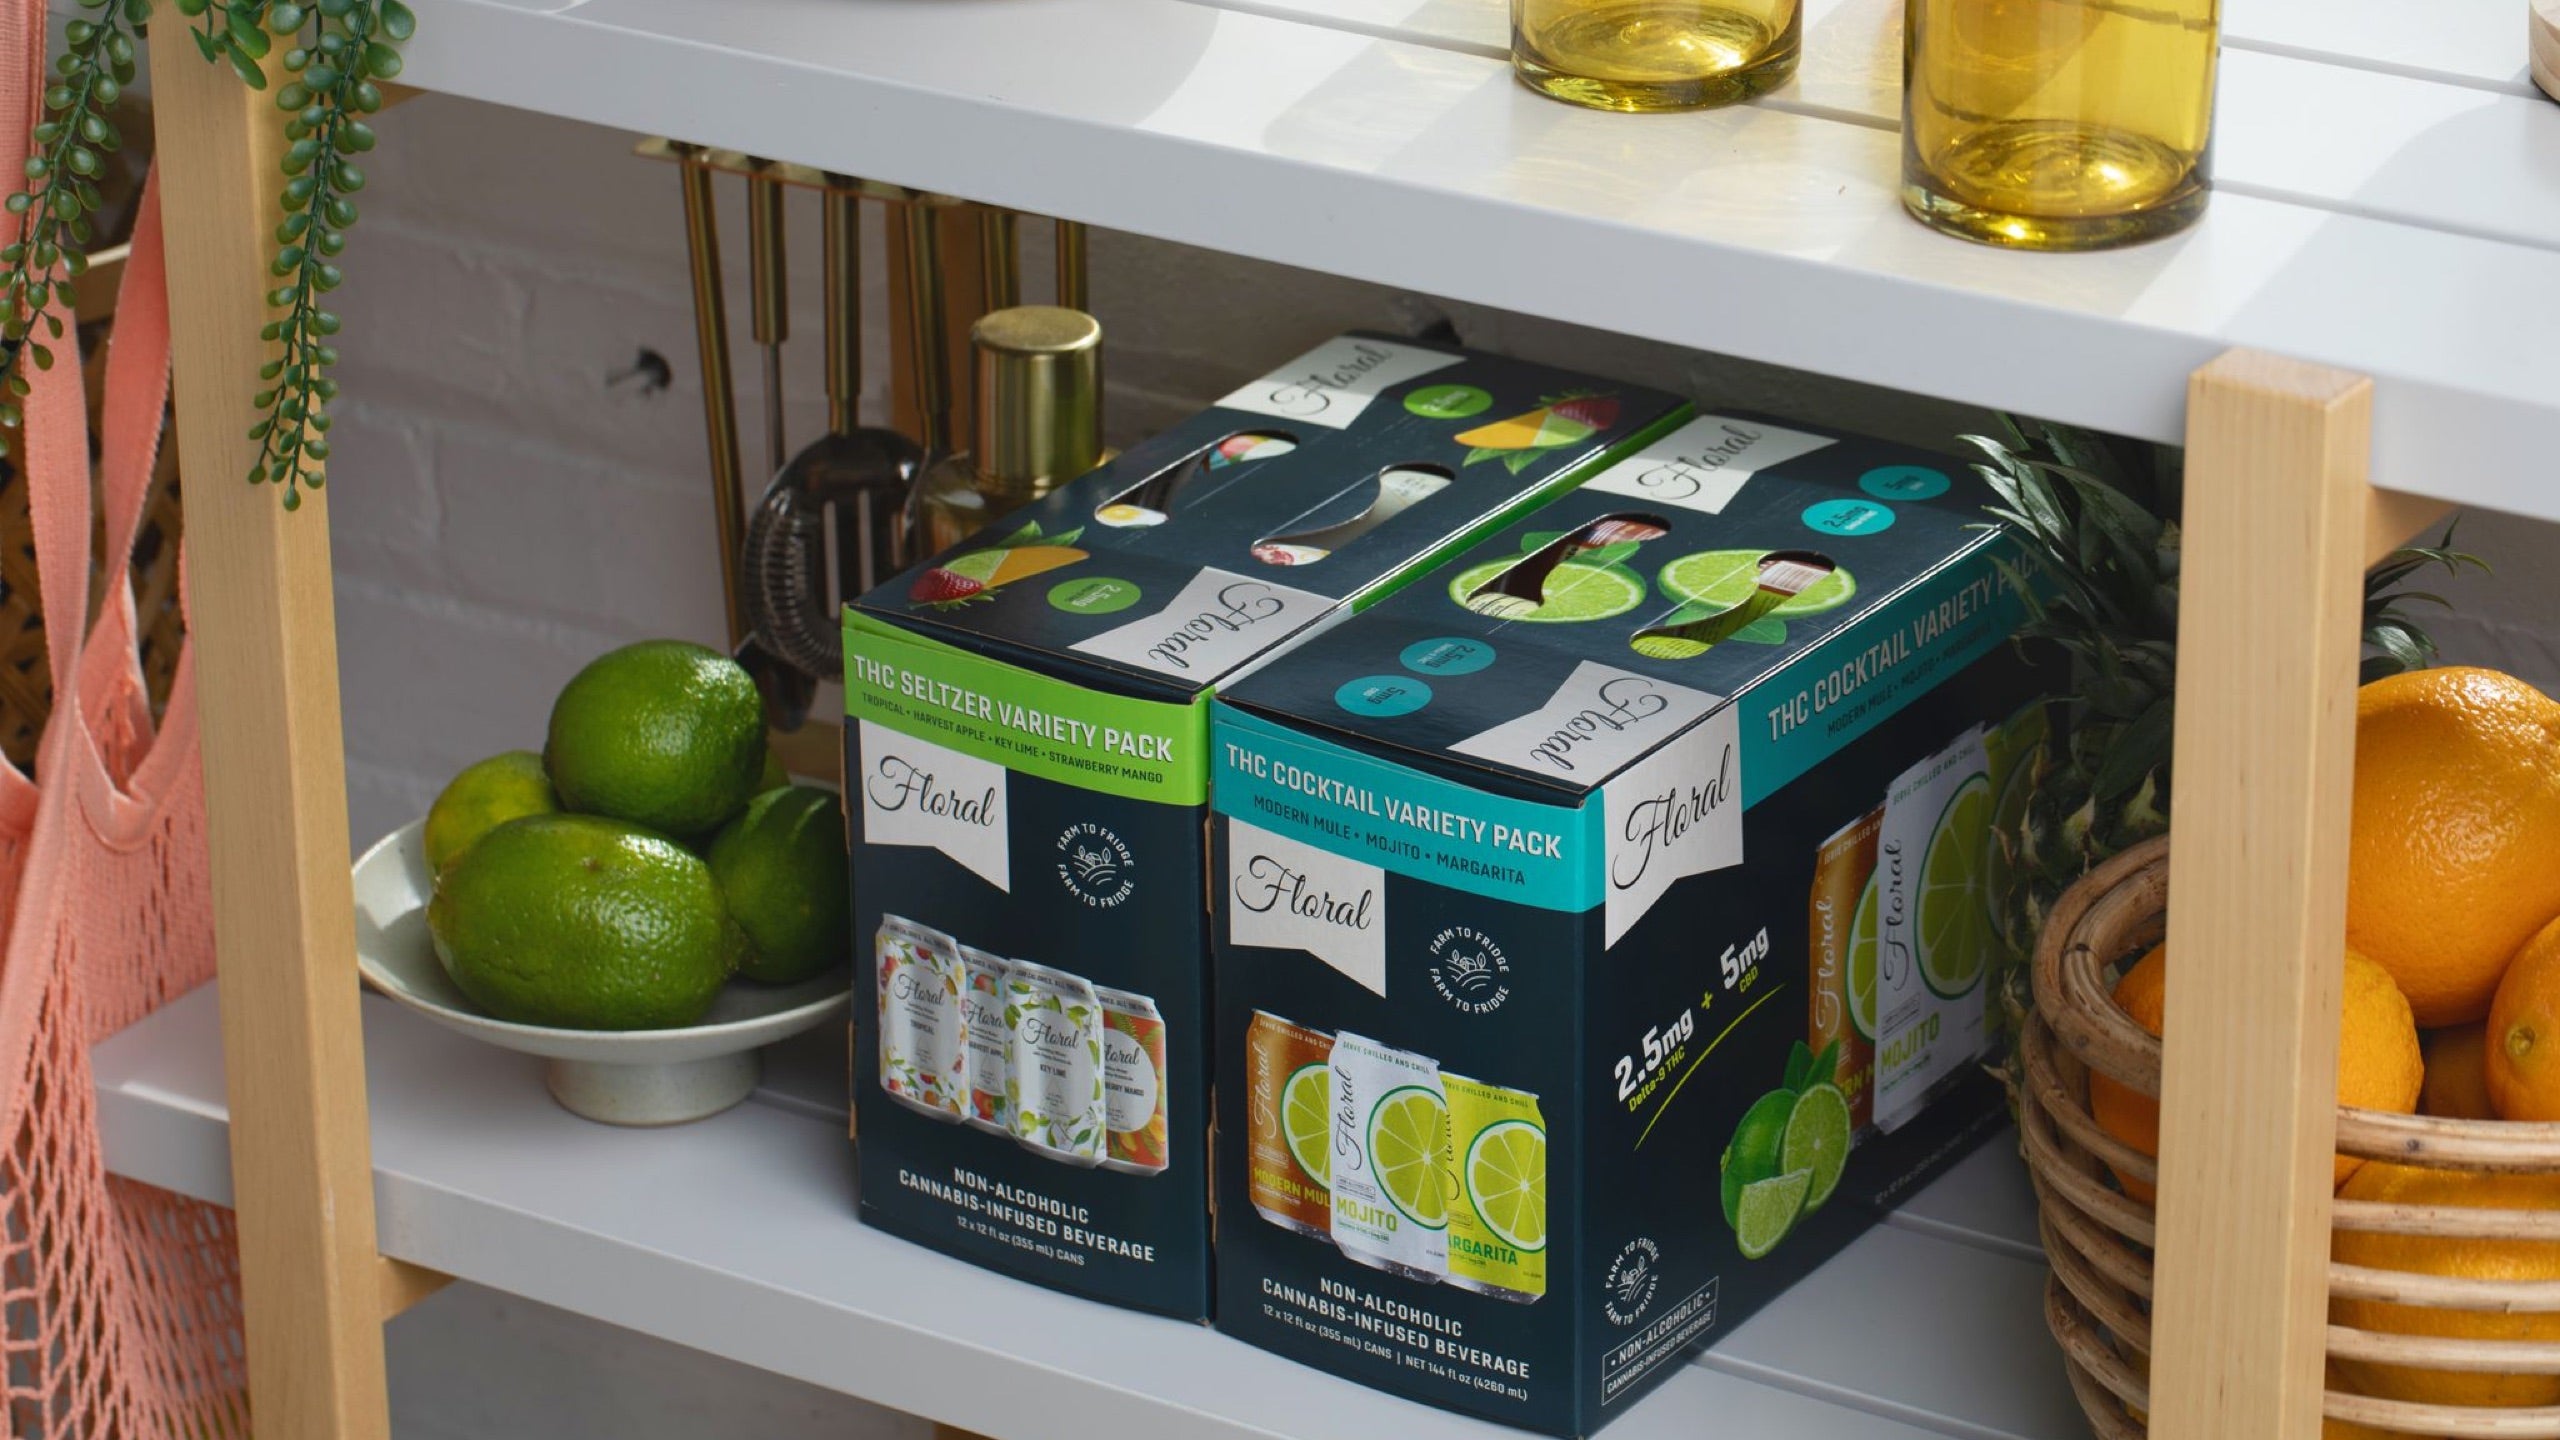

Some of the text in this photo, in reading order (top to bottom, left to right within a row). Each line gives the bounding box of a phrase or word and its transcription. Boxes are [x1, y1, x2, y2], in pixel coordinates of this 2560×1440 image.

[1269, 343, 1395, 416] Floral
[1637, 424, 1762, 500] Floral
[1149, 582, 1285, 668] Floral
[1768, 691, 1809, 741] THC
[1814, 632, 1910, 714] COCKTAIL
[1913, 571, 1992, 649] VARIETY
[853, 655, 1174, 763] THC SELTZER VARIETY PACK
[862, 692, 1164, 784] TROPICAL HARVEST APPLE KEY LIME STRAWBERRY MANGO
[1530, 678, 1668, 771] Floral
[1827, 702, 1867, 737] MODERN
[868, 755, 995, 827] Floral
[1226, 744, 1563, 859] THC COCKTAIL VARIETY PACK
[1612, 744, 1730, 889] Floral
[1057, 823, 1134, 867] FARM TO FRIDGE
[1254, 794, 1526, 886] MODERN MULE MOJITO MARGARITA
[1057, 864, 1134, 908] FARM TO FRIDGE
[1235, 855, 1373, 929] Floral
[1883, 838, 1909, 992] Floral
[1430, 926, 1510, 973] FARM TO FRIDGE
[1739, 965, 1759, 993] CBD
[1815, 895, 1841, 1039] Floral
[894, 973, 945, 1006] Floral
[966, 998, 1005, 1029] Flora
[1430, 968, 1510, 1014] FARM TO FRIDGE
[1614, 926, 1770, 1102] 2.5mg + 5mg
[1022, 1018, 1079, 1049] Floral
[1395, 1058, 1409, 1067] AND
[1881, 1012, 1940, 1075] MOJITO
[1253, 1041, 1277, 1140] Floral
[1462, 1086, 1491, 1099] CHILLED
[1493, 1094, 1508, 1103] AND
[1628, 1045, 1686, 1112] Delta-9 THC
[1335, 1065, 1362, 1171] Floral
[899, 1168, 1155, 1262] CANNABIS-INFUSED BEVERAGE
[954, 1167, 1089, 1224] NON-ALCOHOLIC
[1254, 1167, 1301, 1197] MODERN
[1304, 1186, 1330, 1208] MUL
[1336, 1195, 1397, 1232] MOJITO
[957, 1215, 967, 1228] 12
[976, 1221, 987, 1235] 12
[999, 1231, 1010, 1242] oz
[1011, 1233, 1034, 1252] (355
[1035, 1243, 1054, 1260] mL)
[1056, 1249, 1085, 1266] CANS
[1606, 1238, 1660, 1289] FARM TO FRIDGE
[1262, 1278, 1530, 1379] CANNABIS-INFUSED BEVERAGE
[1320, 1277, 1462, 1338] NON-ALCOHOLIC
[1605, 1274, 1660, 1326] FARM TO FRIDGE
[1619, 1293, 1704, 1365] NON-ALCOHOLIC
[1263, 1304, 1273, 1316] 12
[1283, 1311, 1293, 1324] 12
[1295, 1315, 1303, 1329] fl
[1305, 1322, 1316, 1333] oz
[1318, 1325, 1341, 1342] (355
[1343, 1335, 1361, 1351] mL)
[1364, 1341, 1392, 1359] CANS
[1406, 1354, 1426, 1371] NET
[1428, 1362, 1445, 1377] 144
[1448, 1367, 1456, 1380] fl
[1458, 1373, 1471, 1385] oz
[1473, 1375, 1505, 1395] (4260
[1507, 1386, 1528, 1402] mL)
[1607, 1309, 1712, 1394] CANNABIS-INFUSED BEVERAGE
